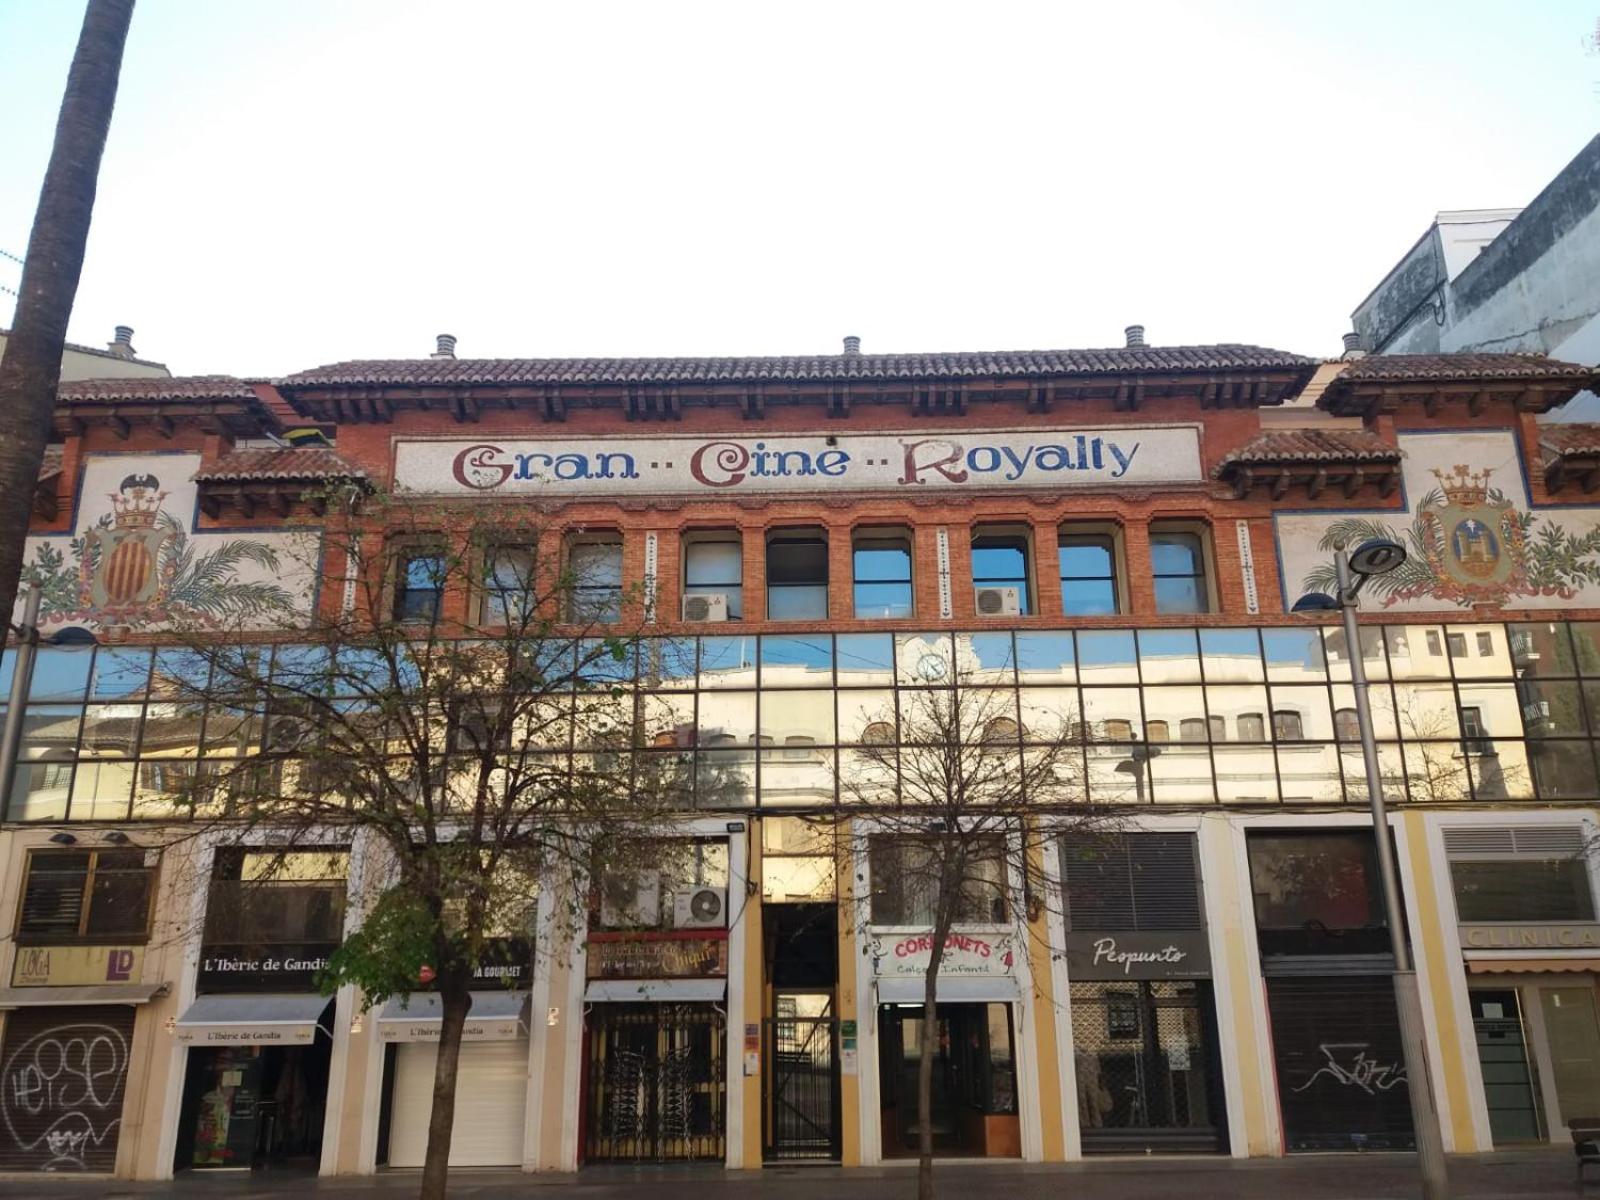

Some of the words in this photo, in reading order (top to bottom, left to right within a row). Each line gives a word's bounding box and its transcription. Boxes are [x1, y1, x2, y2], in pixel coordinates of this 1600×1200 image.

[452, 444, 639, 489] Gran
[690, 442, 851, 487] Cine
[898, 435, 1140, 485] Royalty
[263, 958, 280, 971] de
[240, 1031, 250, 1040] de
